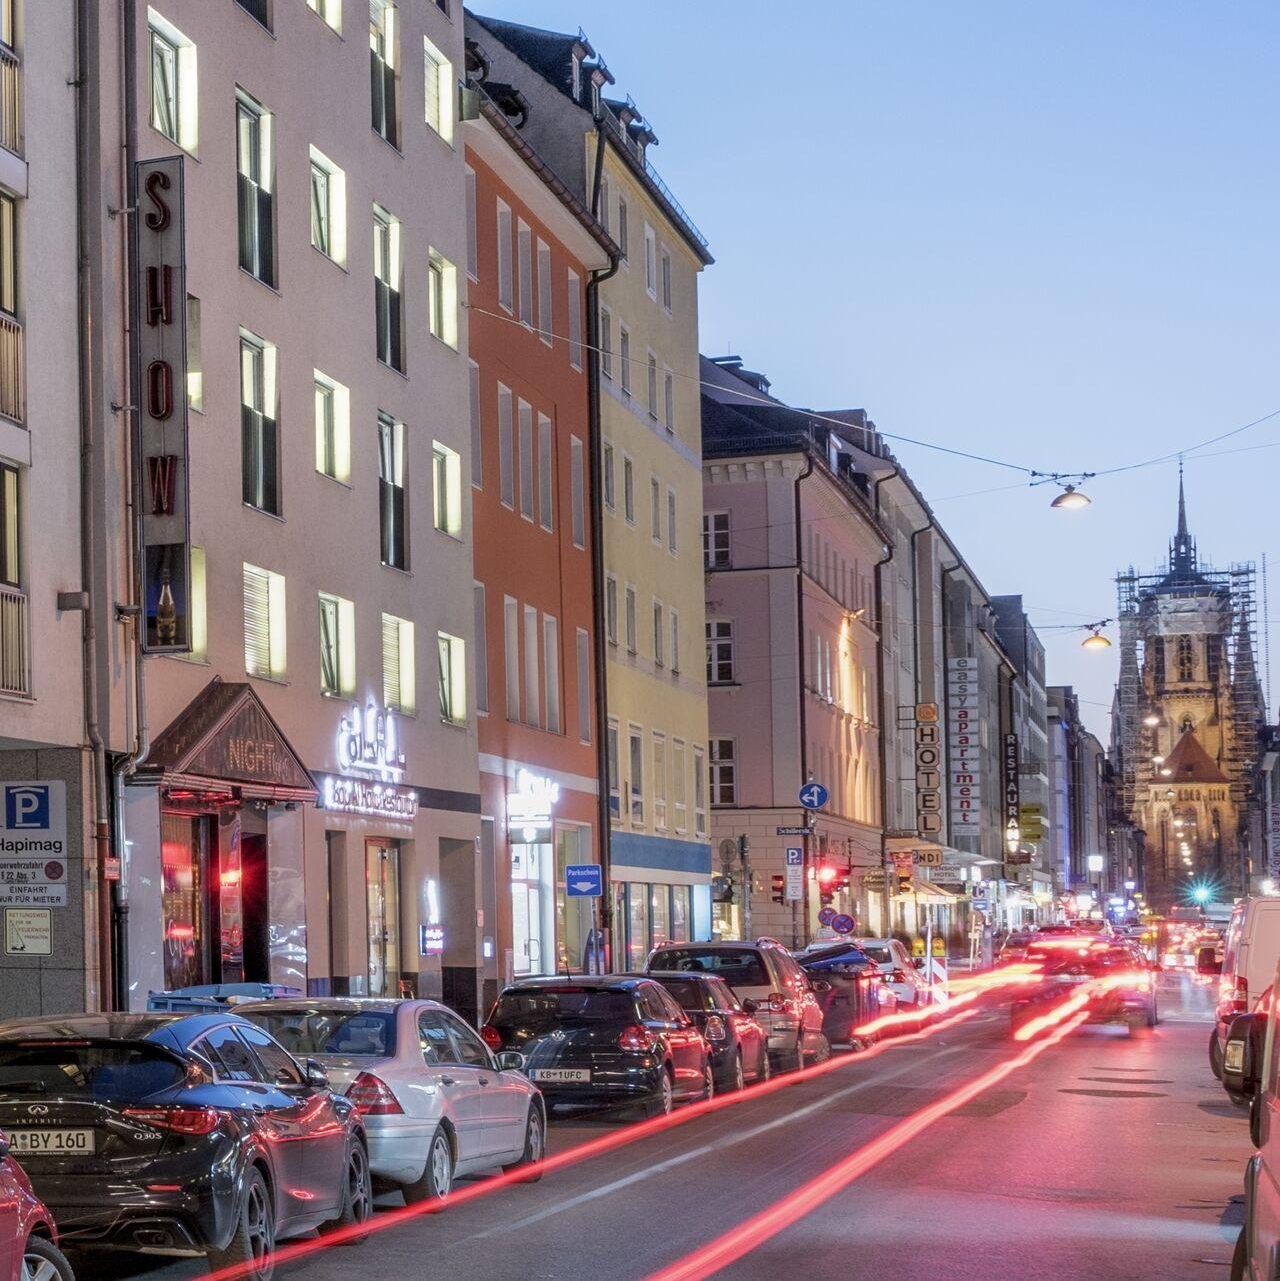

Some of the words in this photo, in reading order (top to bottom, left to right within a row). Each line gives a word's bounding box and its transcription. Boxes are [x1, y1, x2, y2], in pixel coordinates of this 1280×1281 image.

[145, 171, 178, 515] SHOW
[229, 737, 274, 772] NIGHT
[920, 728, 936, 831] HOTEL
[16, 793, 39, 823] P
[6, 872, 14, 880] 22
[16, 895, 30, 903] FÜR
[540, 1071, 551, 1079] KB
[30, 1133, 51, 1149] BY
[55, 1133, 86, 1149] 160
[134, 1132, 163, 1140] Q30S
